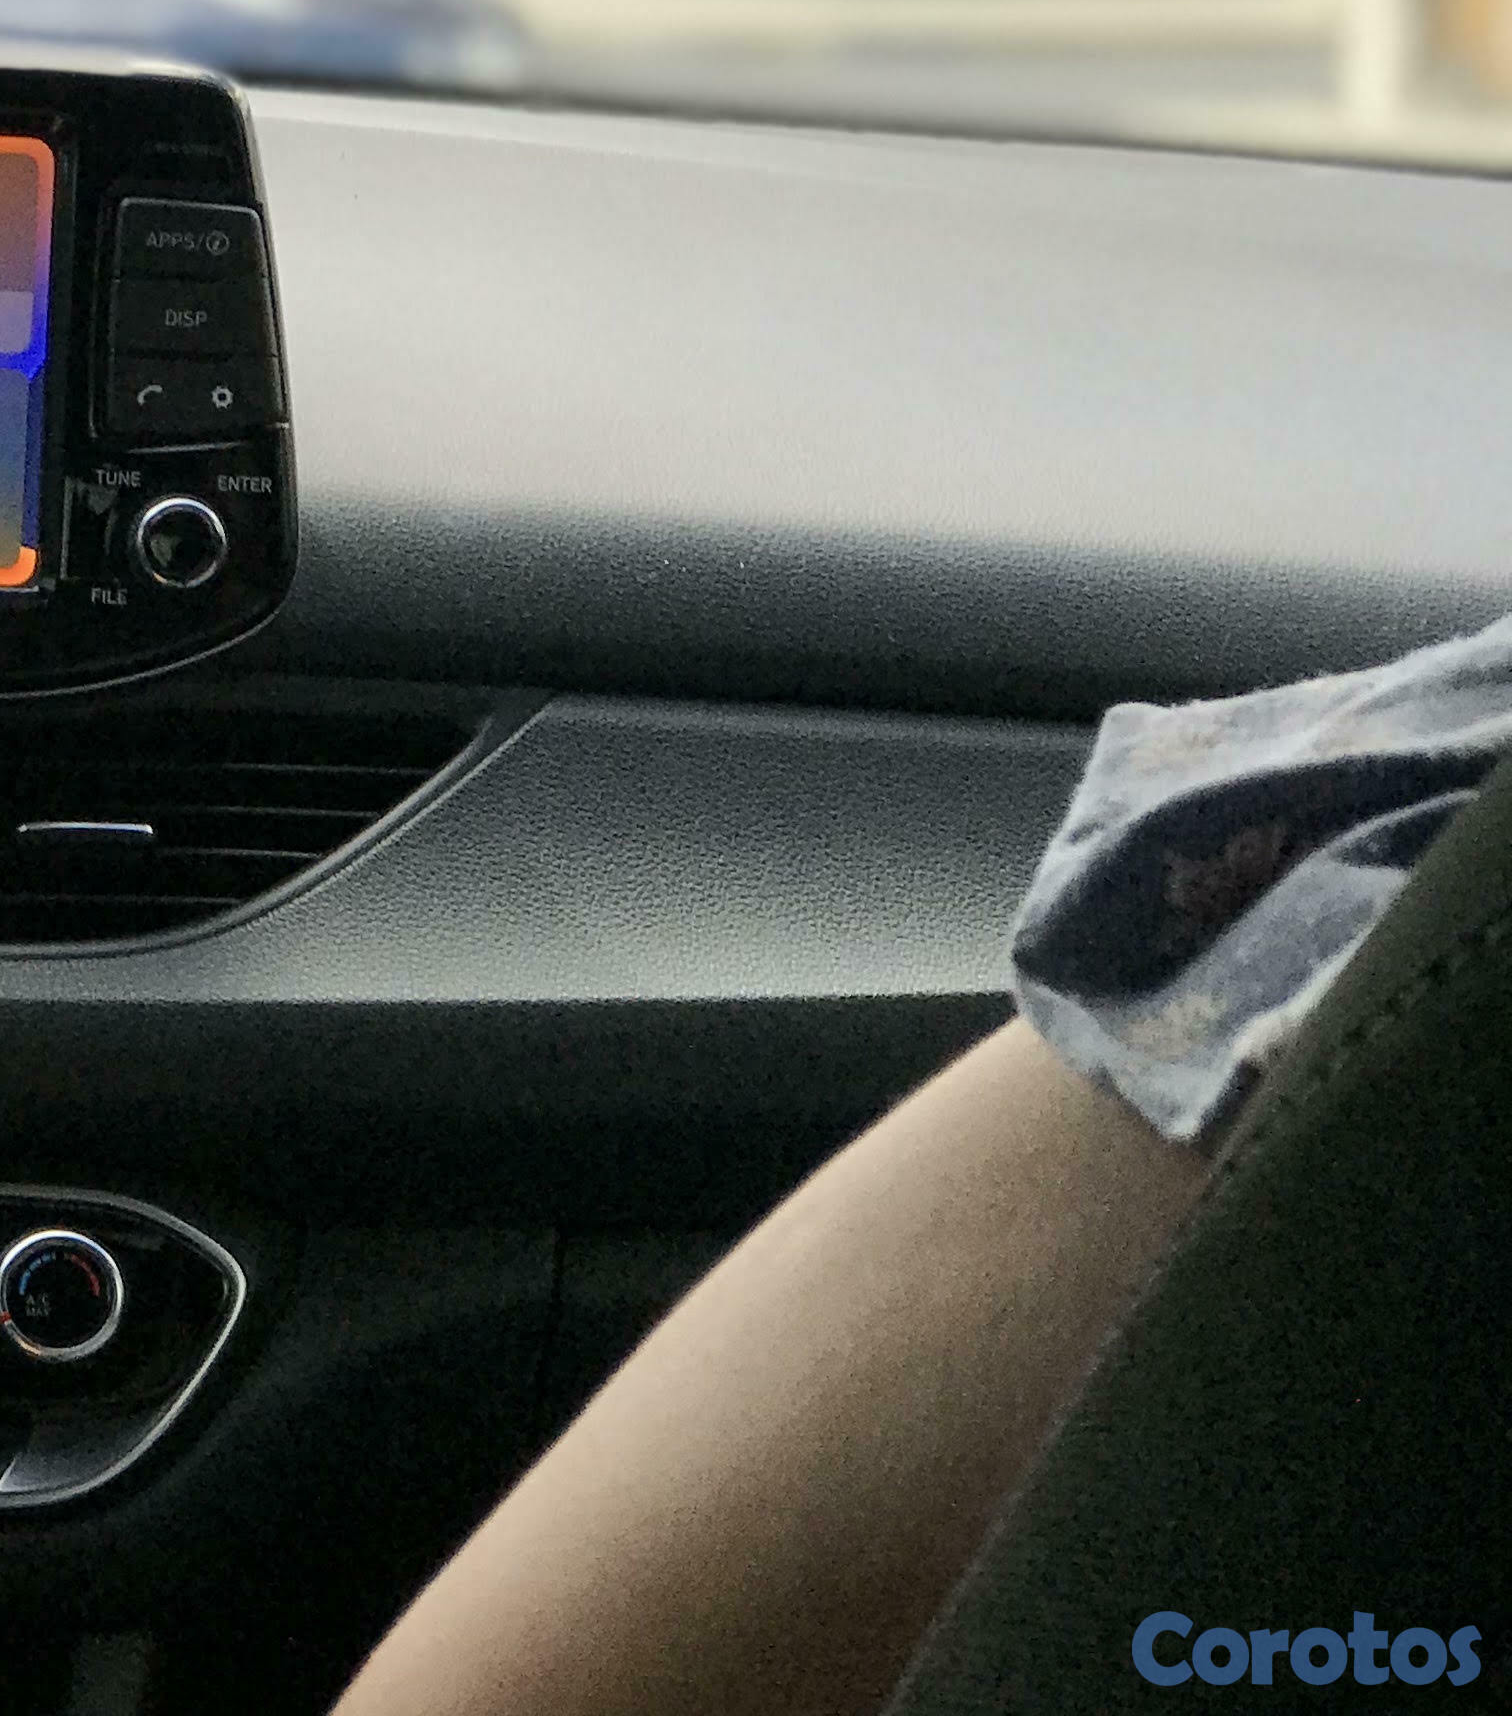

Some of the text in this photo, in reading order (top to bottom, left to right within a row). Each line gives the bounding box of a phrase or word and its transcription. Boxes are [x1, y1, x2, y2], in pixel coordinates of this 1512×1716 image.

[165, 308, 207, 327] DISP
[95, 470, 141, 488] TUNE
[217, 474, 273, 494] ENTER
[91, 587, 128, 606] FILE
